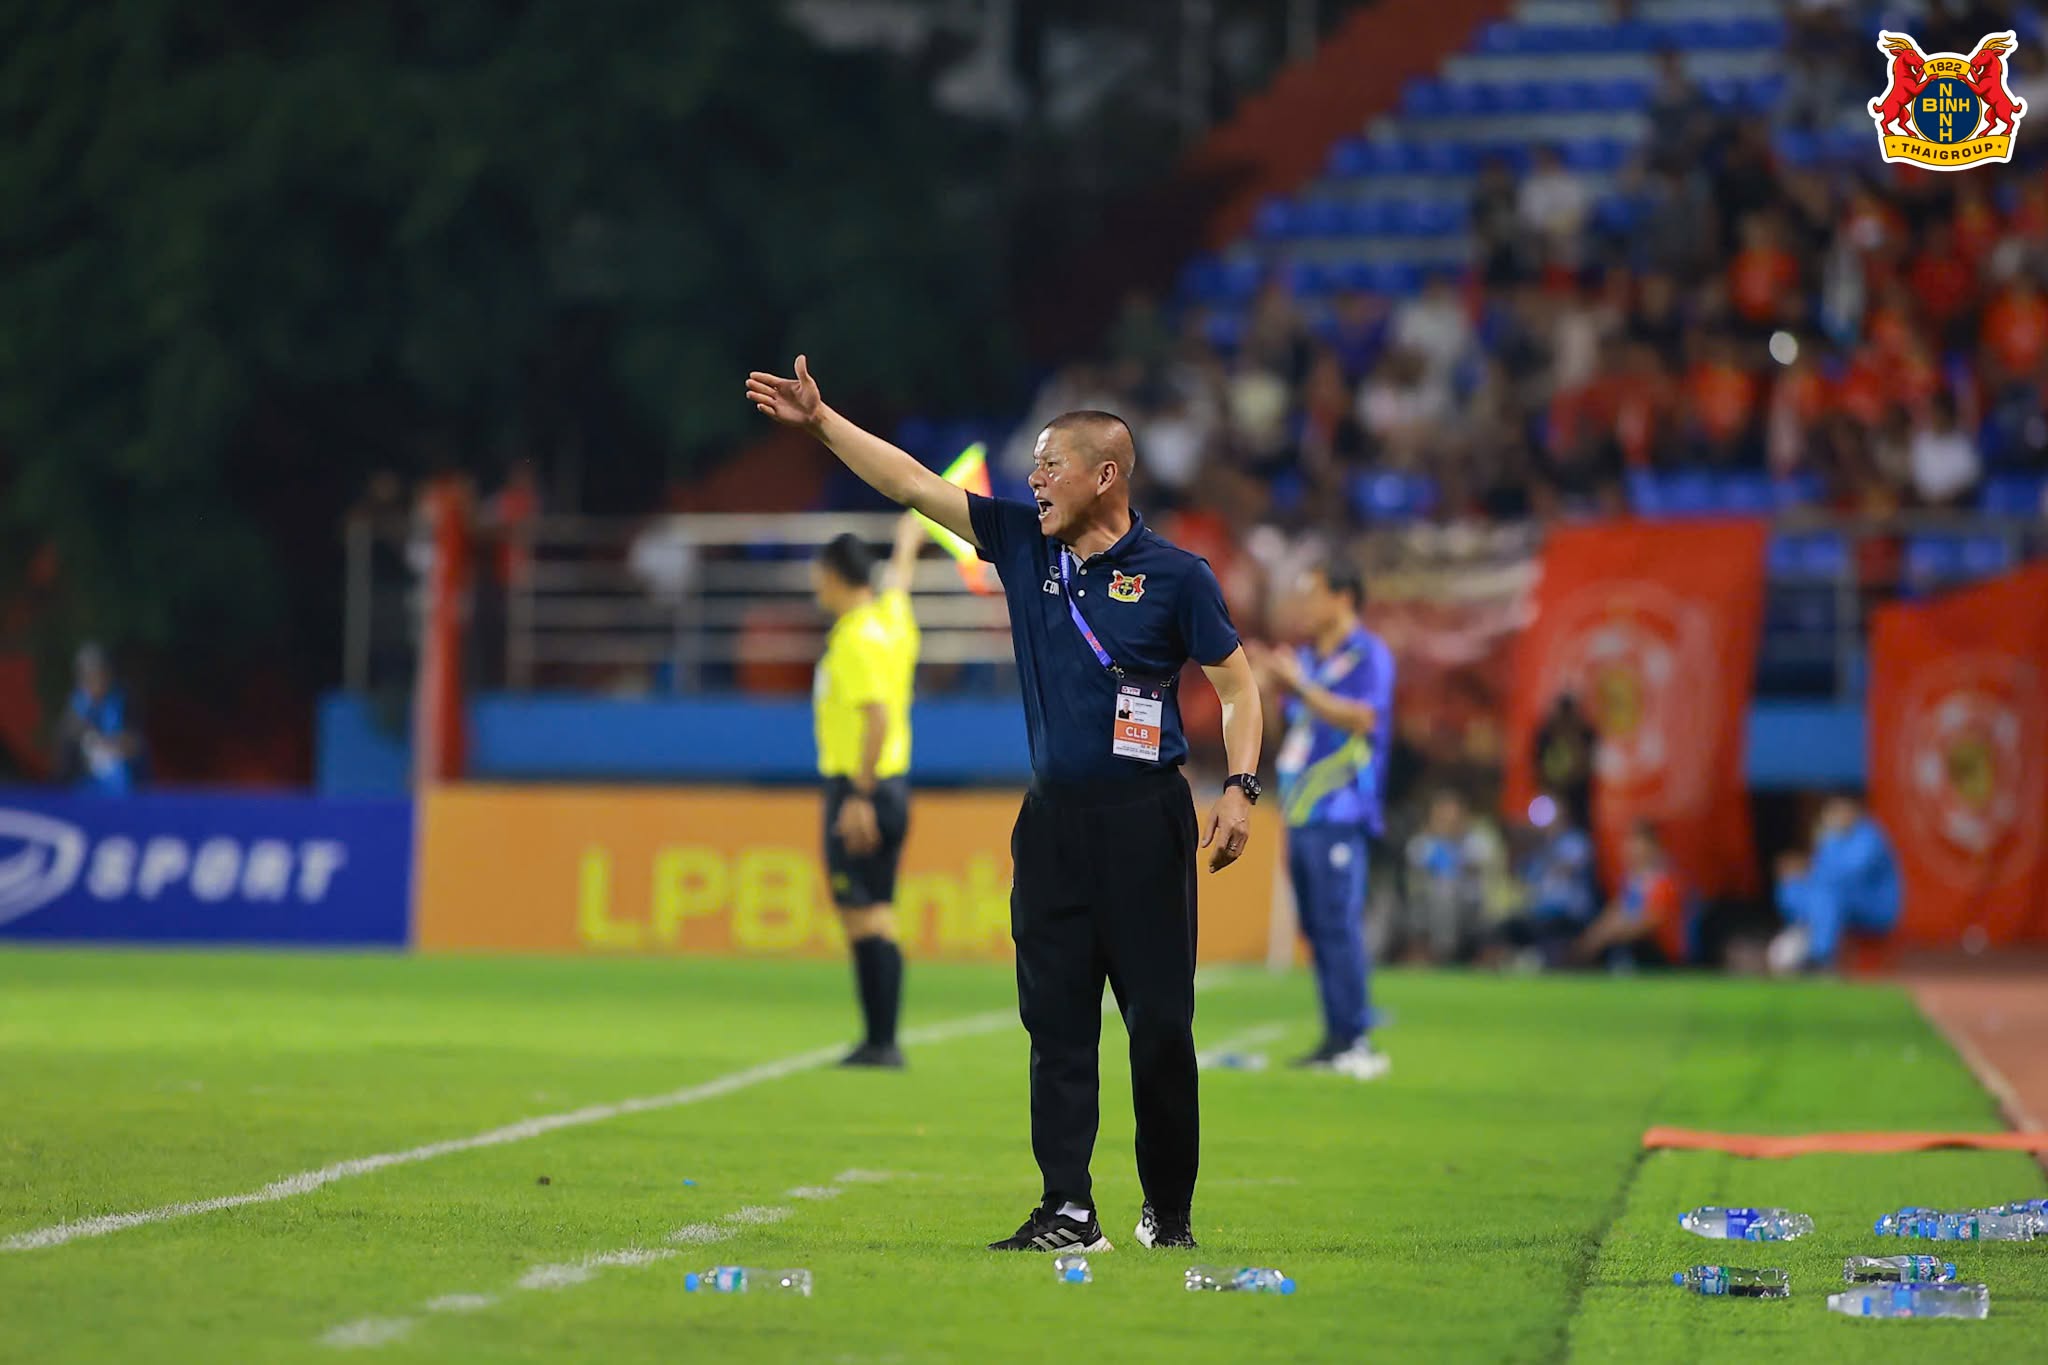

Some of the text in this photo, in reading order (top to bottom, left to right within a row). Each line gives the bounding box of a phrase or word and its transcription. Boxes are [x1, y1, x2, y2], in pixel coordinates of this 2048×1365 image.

[1125, 725, 1149, 739] CLB
[86, 836, 349, 904] SPORT
[578, 844, 1012, 950] LPBnk
